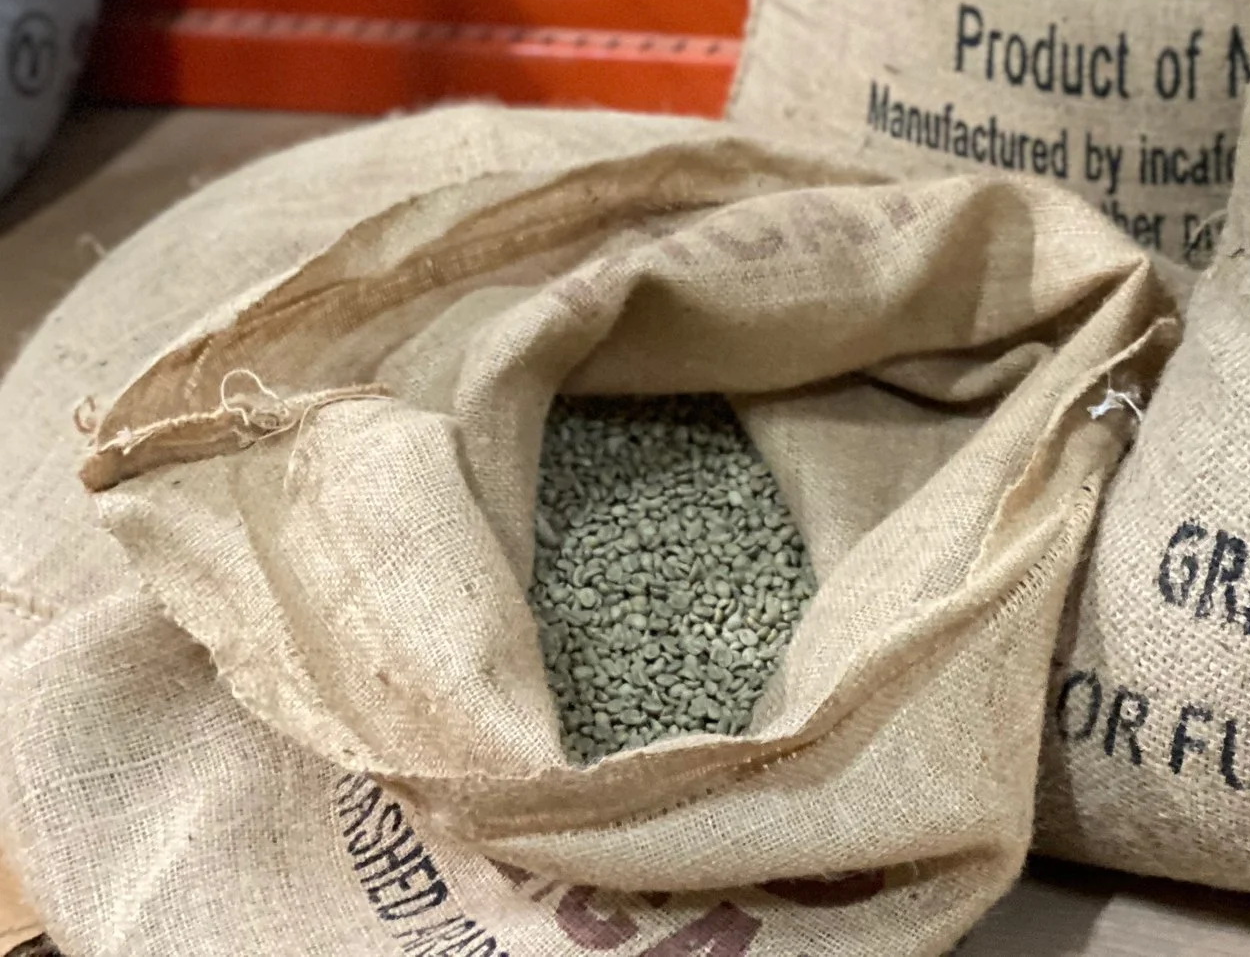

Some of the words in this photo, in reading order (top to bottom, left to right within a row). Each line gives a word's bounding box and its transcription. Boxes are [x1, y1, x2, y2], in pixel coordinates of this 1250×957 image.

[954, 3, 1129, 100] Product
[1155, 28, 1202, 102] of
[867, 80, 1069, 180] Manufactured
[1085, 131, 1122, 194] by
